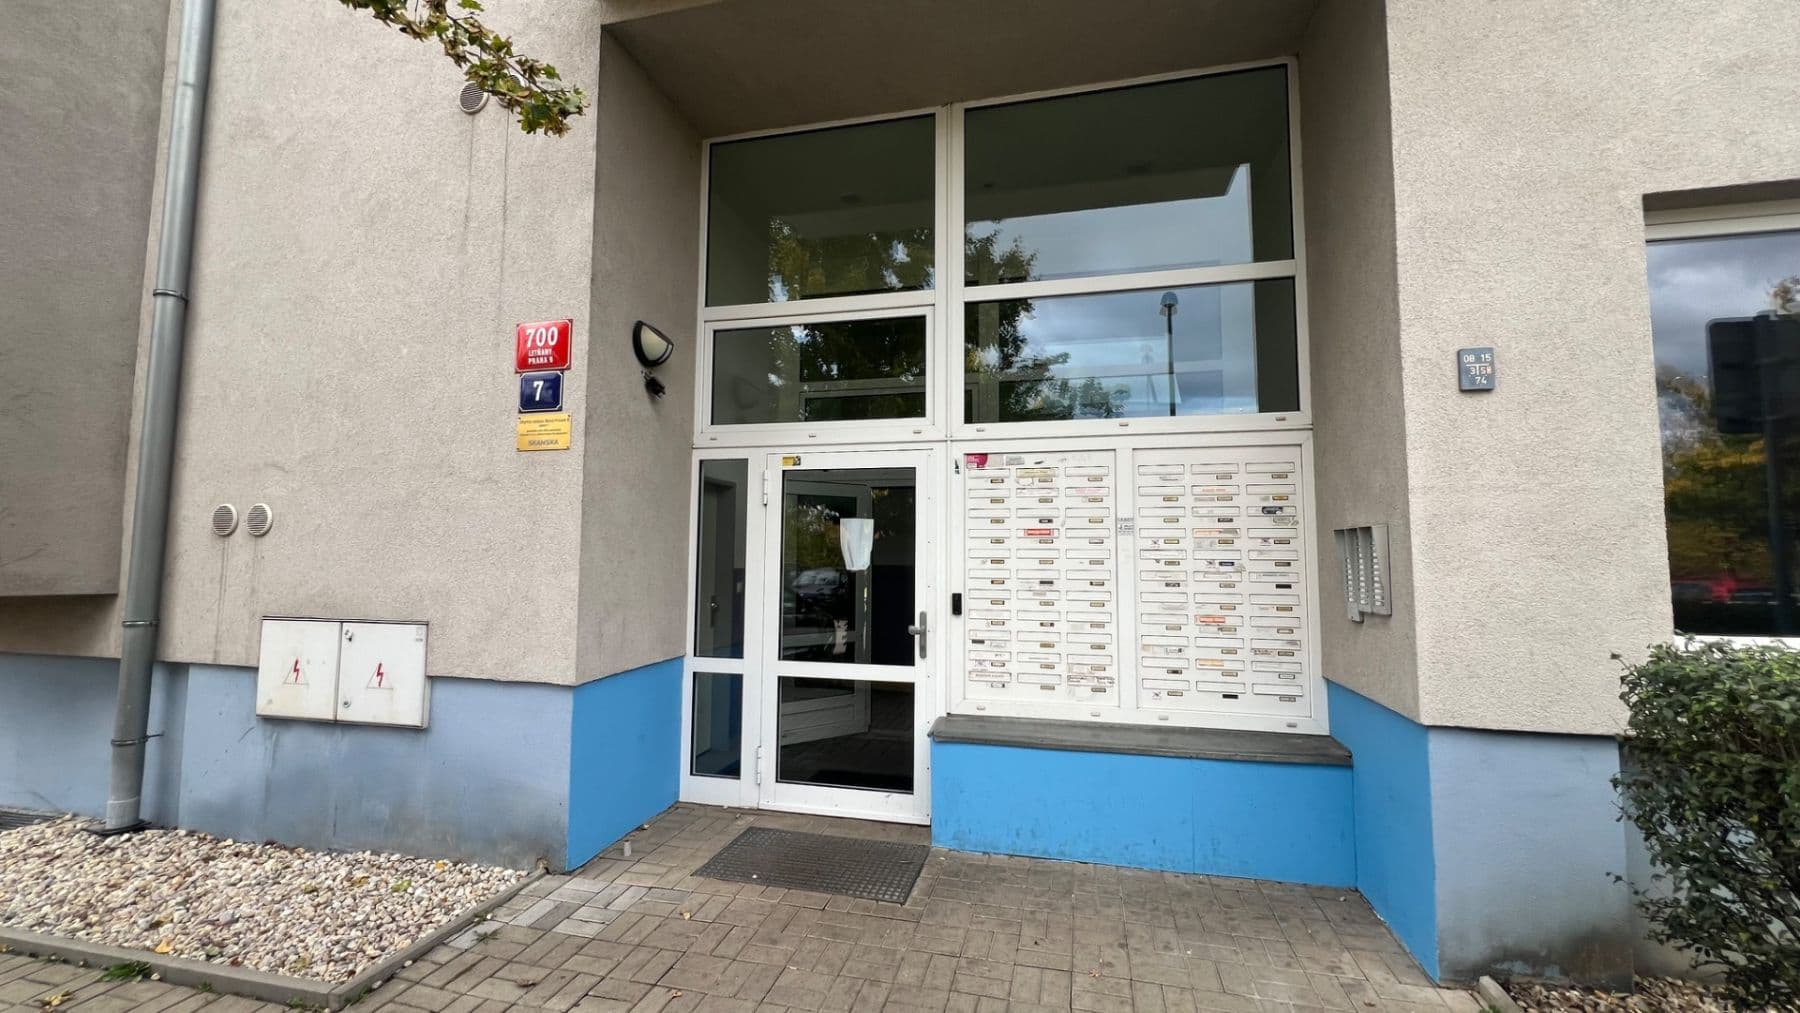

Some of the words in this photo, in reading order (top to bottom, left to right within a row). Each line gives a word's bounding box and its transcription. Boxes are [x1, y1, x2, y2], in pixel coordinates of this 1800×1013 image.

[526, 327, 558, 348] 700
[1480, 353, 1492, 362] 15
[533, 380, 545, 401] 7
